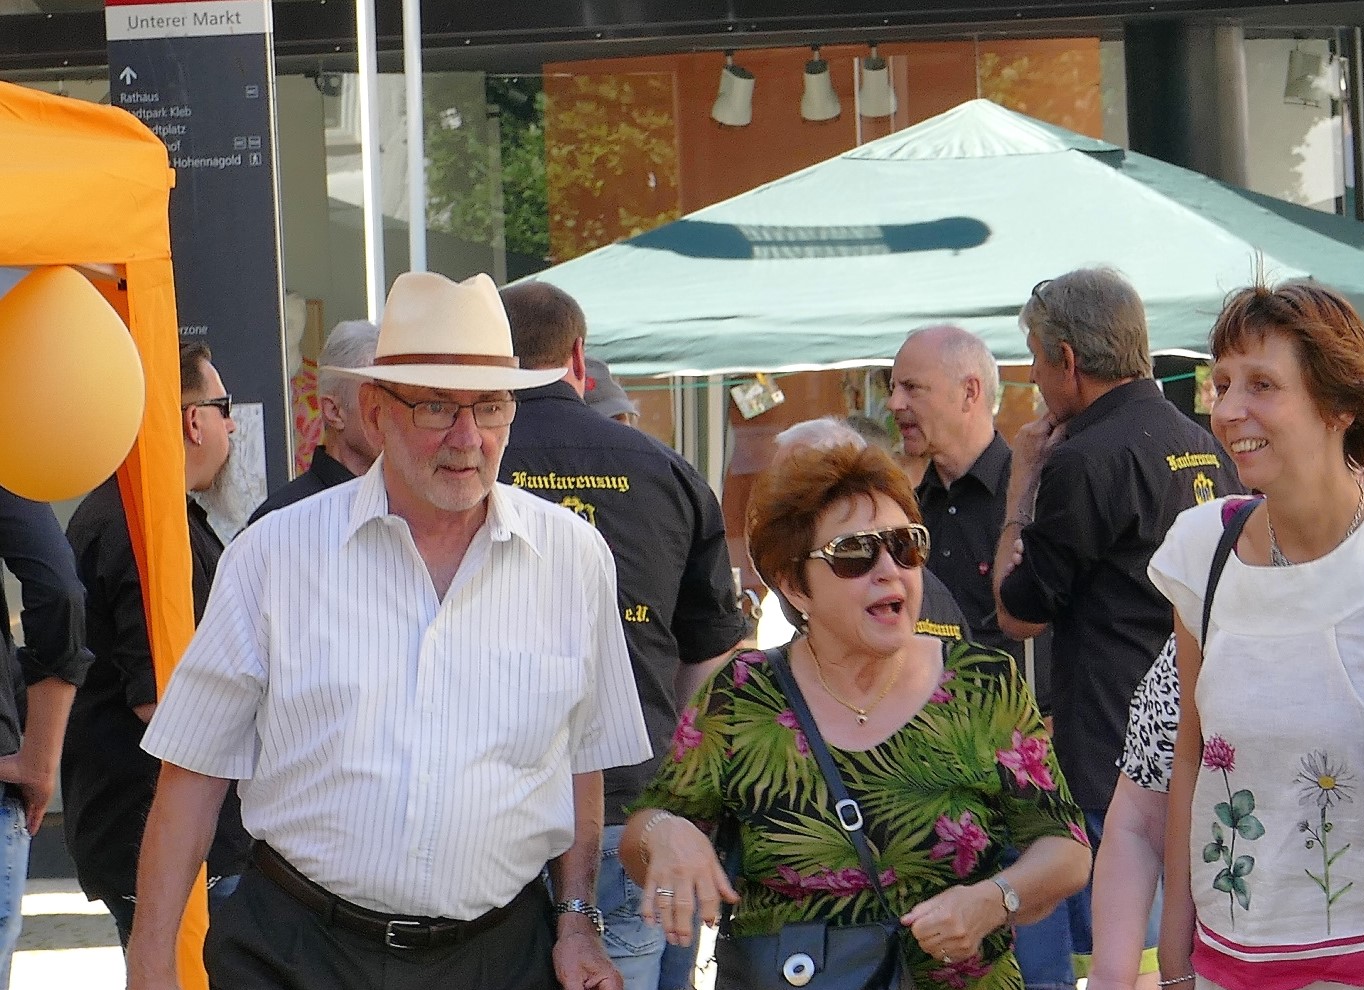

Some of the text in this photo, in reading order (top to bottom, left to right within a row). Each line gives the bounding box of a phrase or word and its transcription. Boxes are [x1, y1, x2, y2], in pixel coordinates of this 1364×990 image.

[127, 10, 242, 30] Unterer Markt
[120, 91, 160, 104] Rathaus
[170, 105, 193, 118] Kleb
[172, 154, 242, 169] Hohennagold
